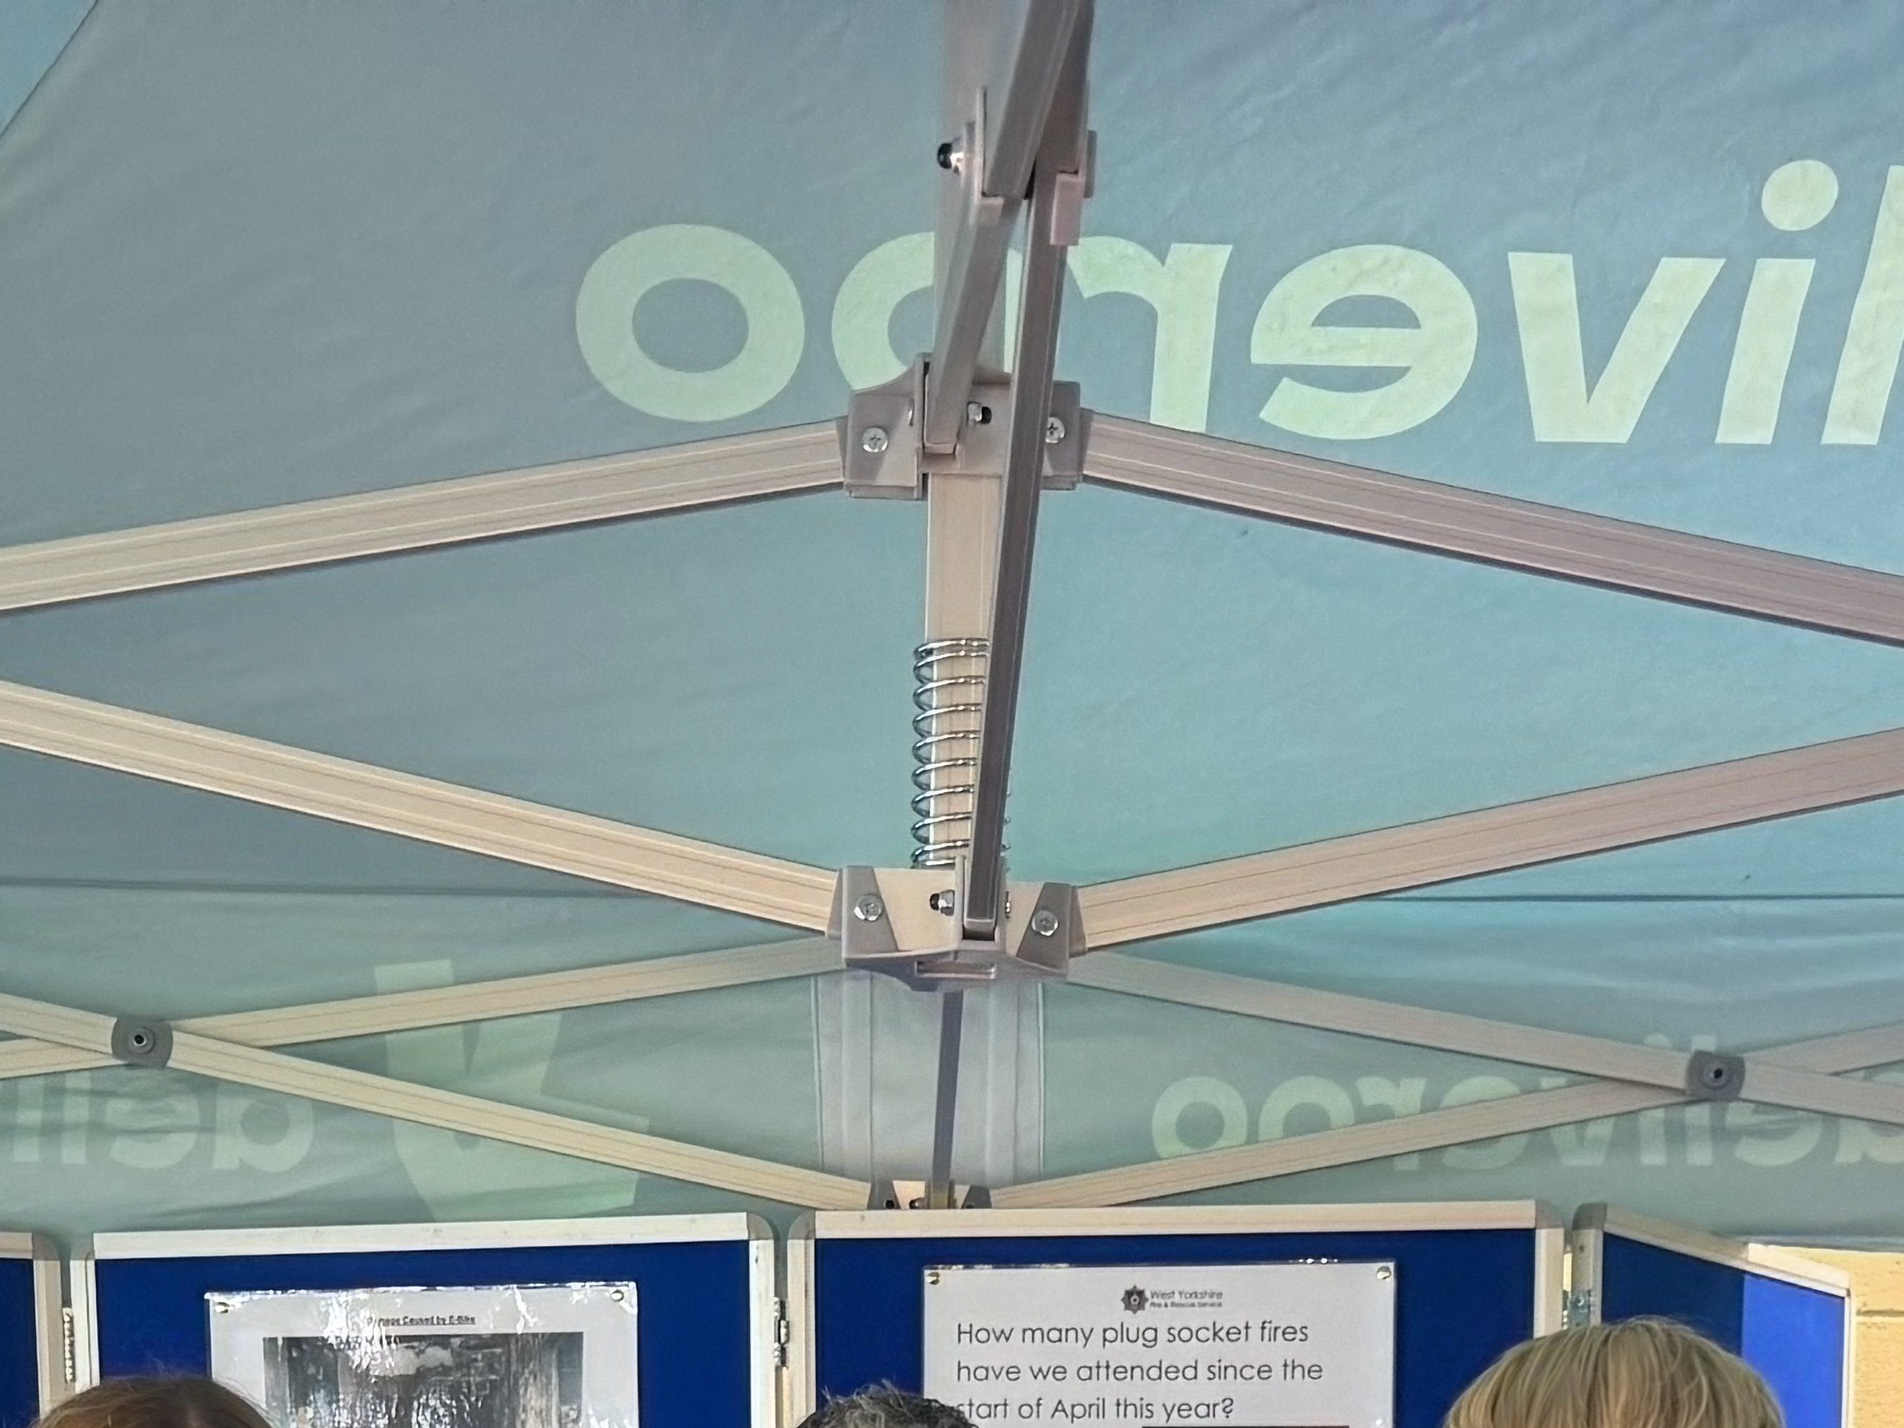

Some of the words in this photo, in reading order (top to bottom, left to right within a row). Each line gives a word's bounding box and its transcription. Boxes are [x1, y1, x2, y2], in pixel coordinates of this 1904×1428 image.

[957, 1323, 1013, 1345] How
[1022, 1327, 1094, 1350] many
[1103, 1321, 1158, 1350] plug
[1167, 1320, 1252, 1344] socket
[1260, 1320, 1309, 1343] fires
[957, 1361, 1021, 1383] have
[1031, 1366, 1068, 1382] we
[1077, 1360, 1198, 1382] attended
[1207, 1360, 1273, 1381] since
[1283, 1359, 1323, 1380] the
[1018, 1398, 1043, 1420] of
[1051, 1398, 1106, 1423] April
[1115, 1397, 1154, 1419] this
[1163, 1398, 1234, 1424] year?
